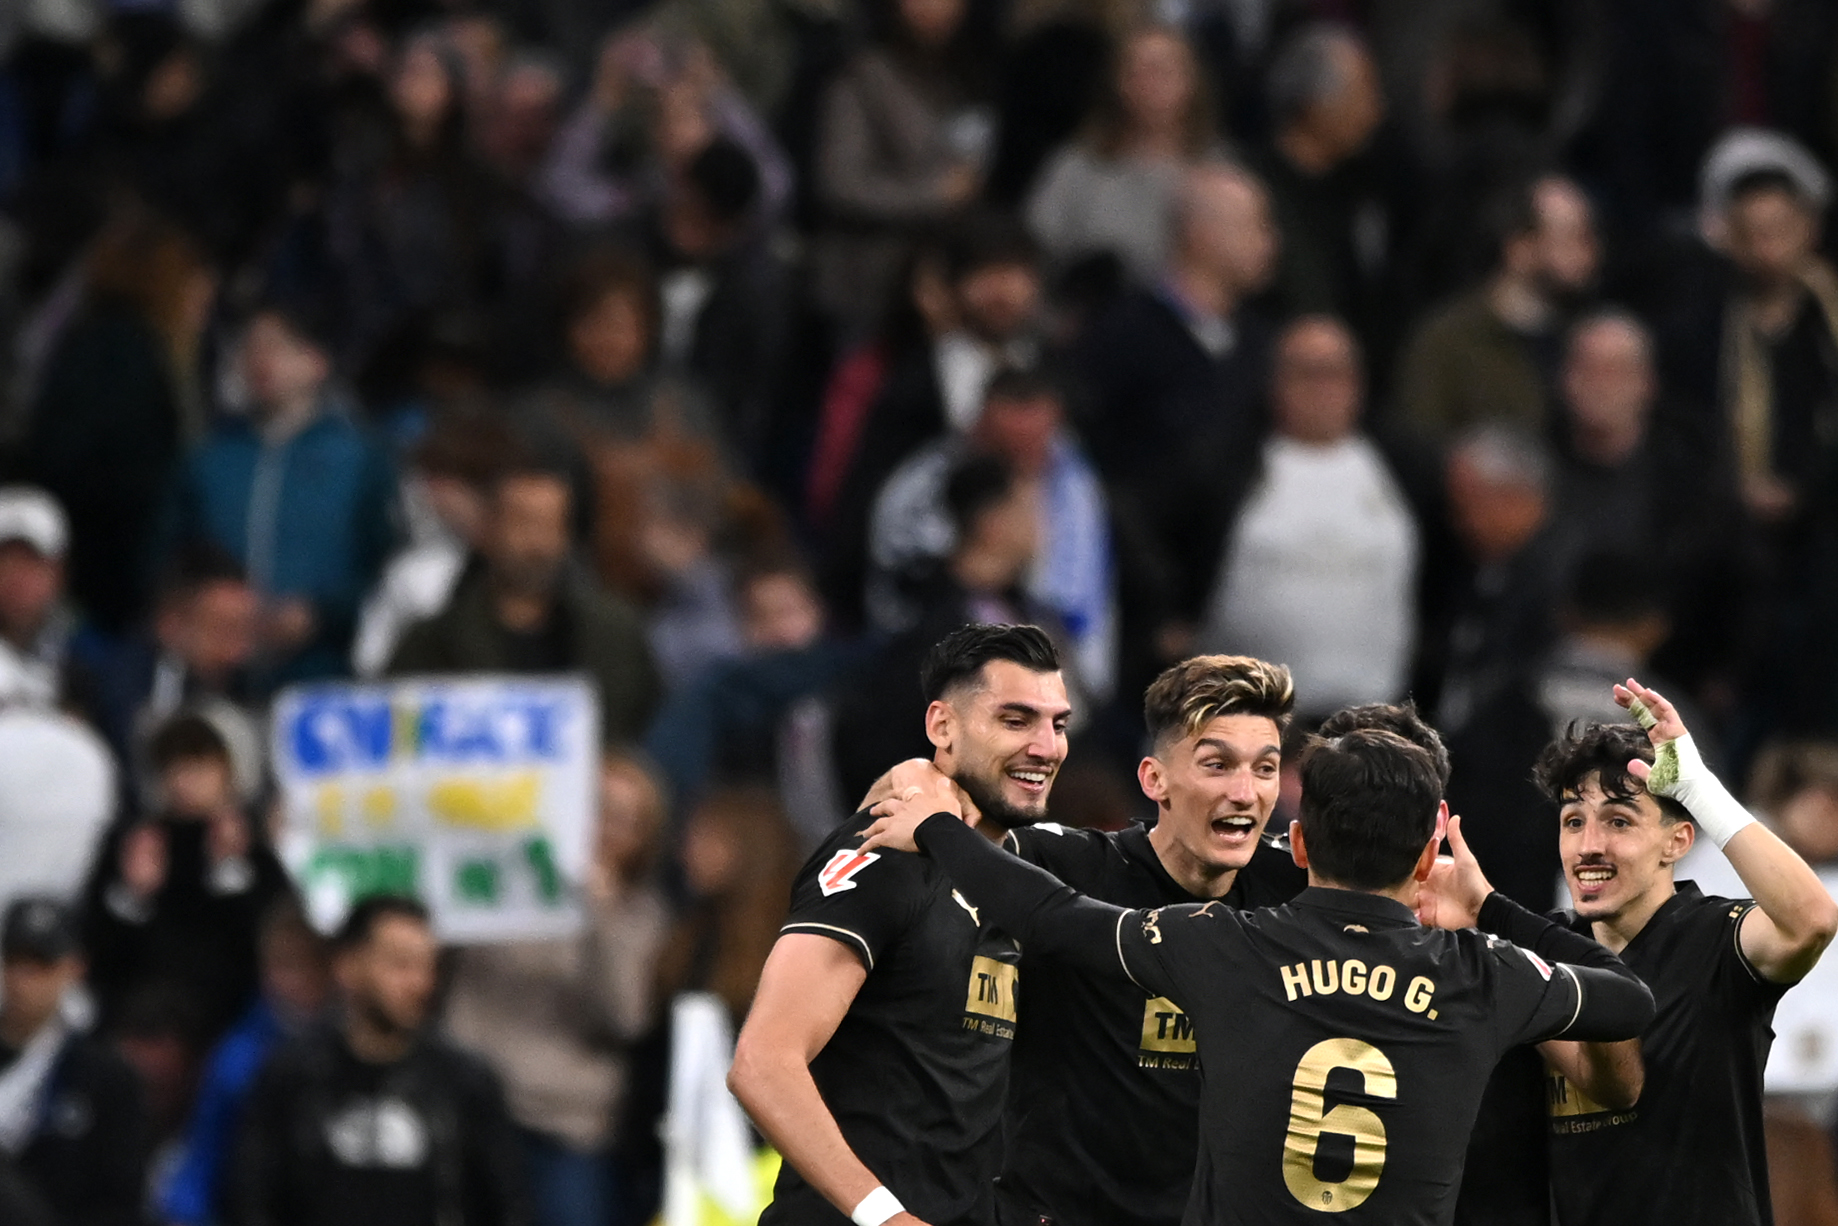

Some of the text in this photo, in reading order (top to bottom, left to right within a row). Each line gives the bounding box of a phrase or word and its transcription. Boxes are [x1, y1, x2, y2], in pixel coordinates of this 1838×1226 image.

[1279, 958, 1440, 1021] HUGO G.
[962, 1017, 980, 1031] TM
[1154, 1011, 1196, 1041] TM
[1137, 1054, 1159, 1069] TM
[1281, 1037, 1398, 1213] 6
